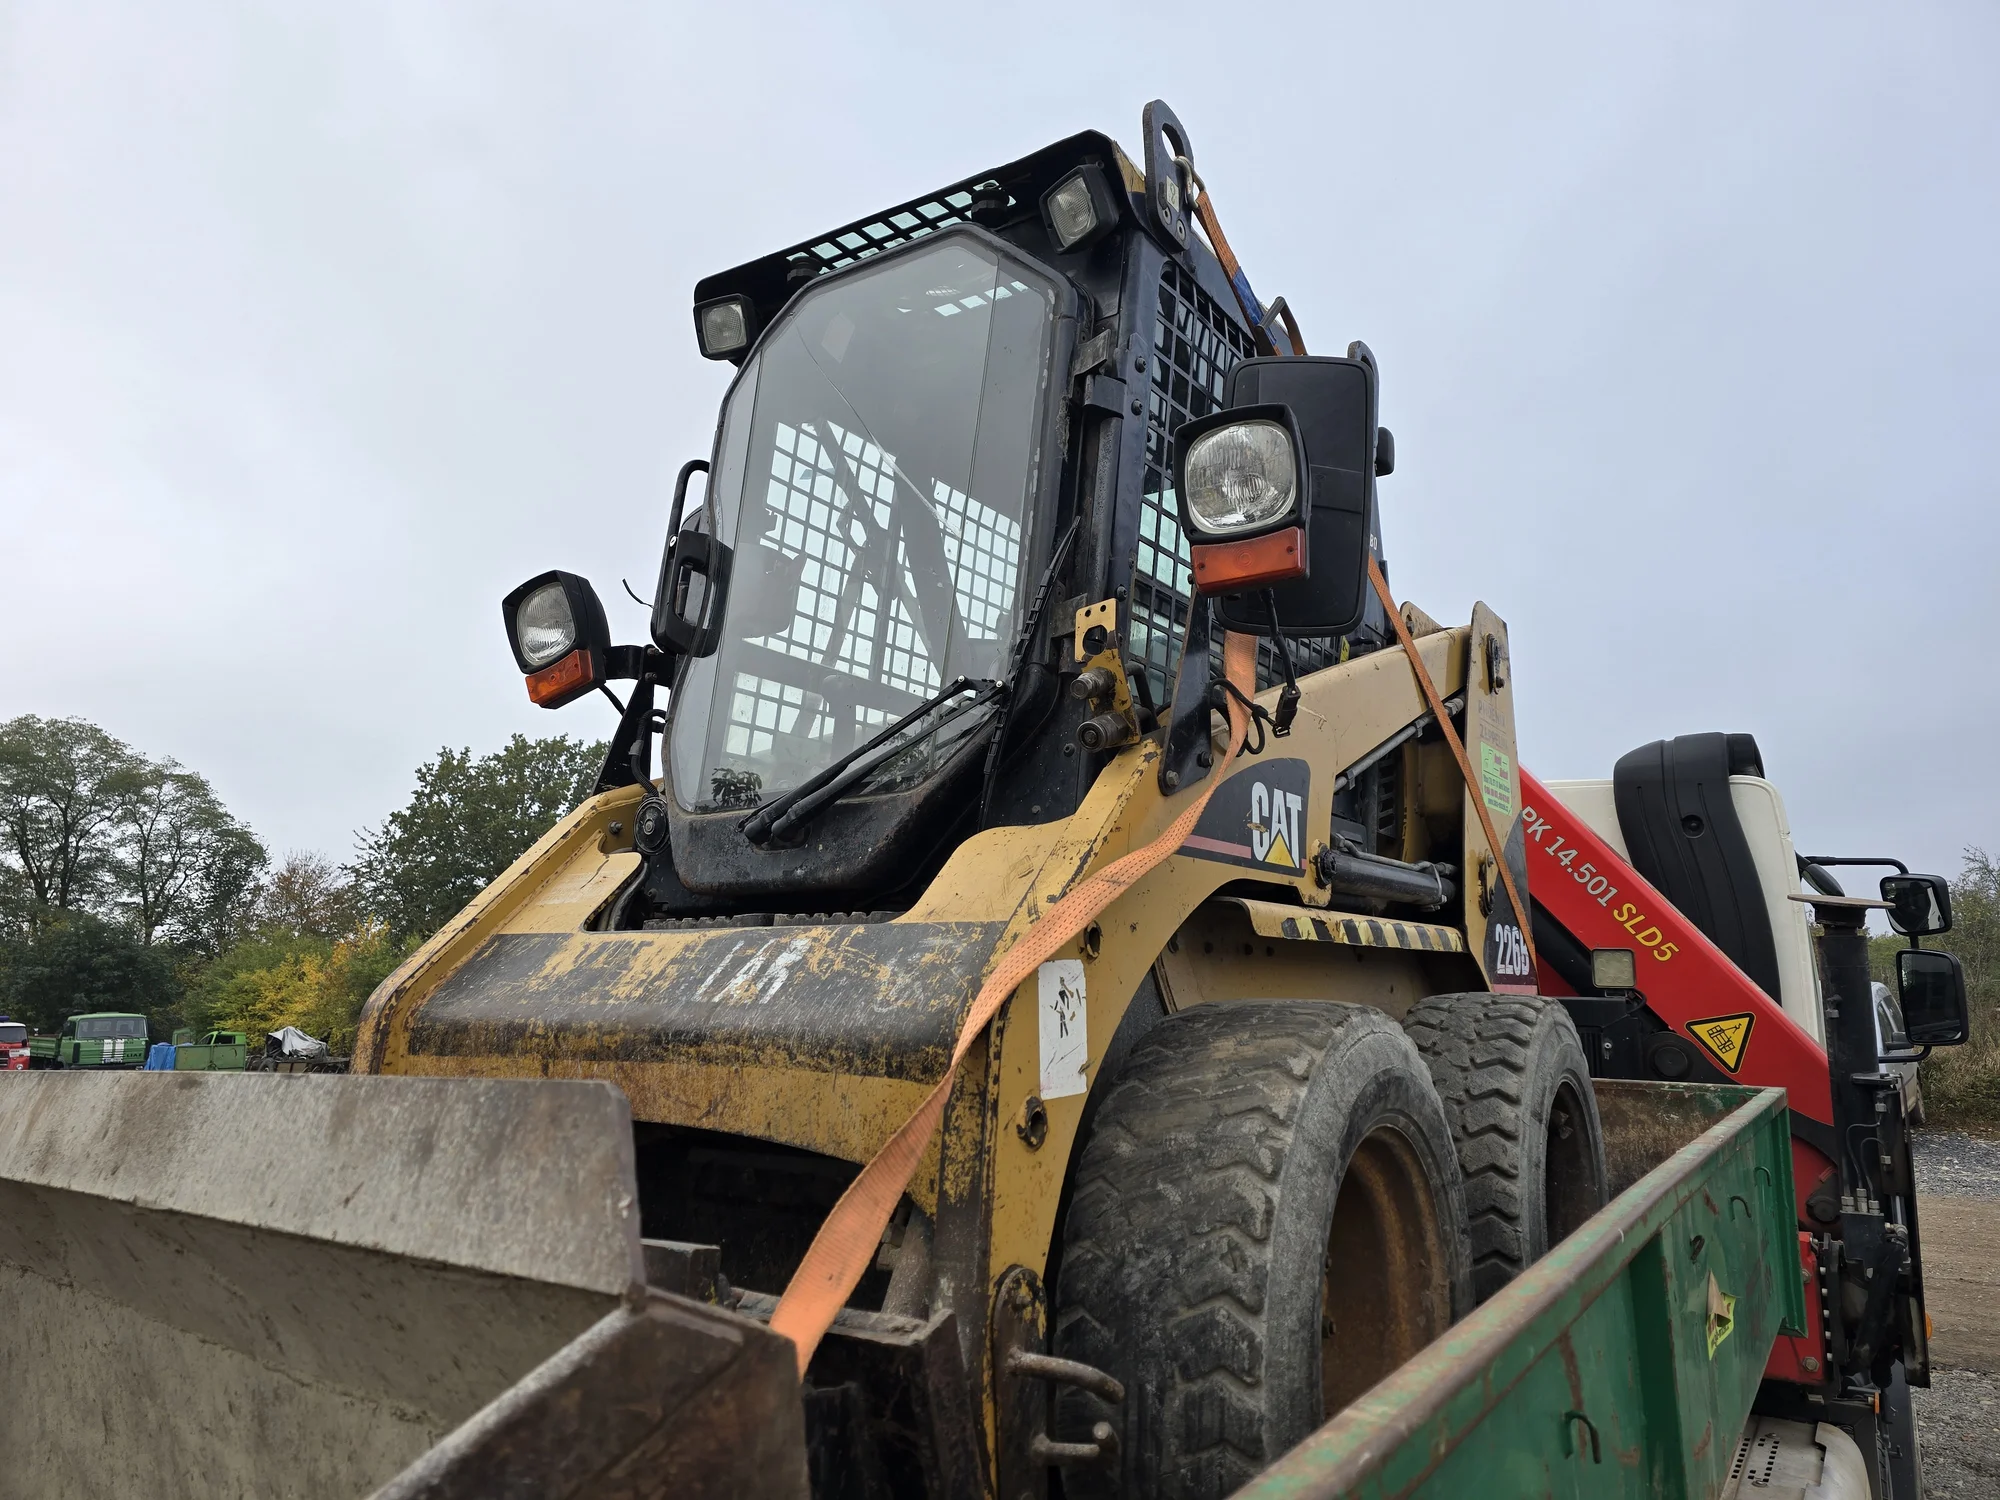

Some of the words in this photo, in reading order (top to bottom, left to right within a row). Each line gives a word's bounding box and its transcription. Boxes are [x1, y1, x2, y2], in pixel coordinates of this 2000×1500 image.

[1251, 781, 1302, 869] CAT
[1522, 805, 1553, 843] PK
[1544, 835, 1619, 908] 14.501
[1613, 902, 1680, 962] SLD5
